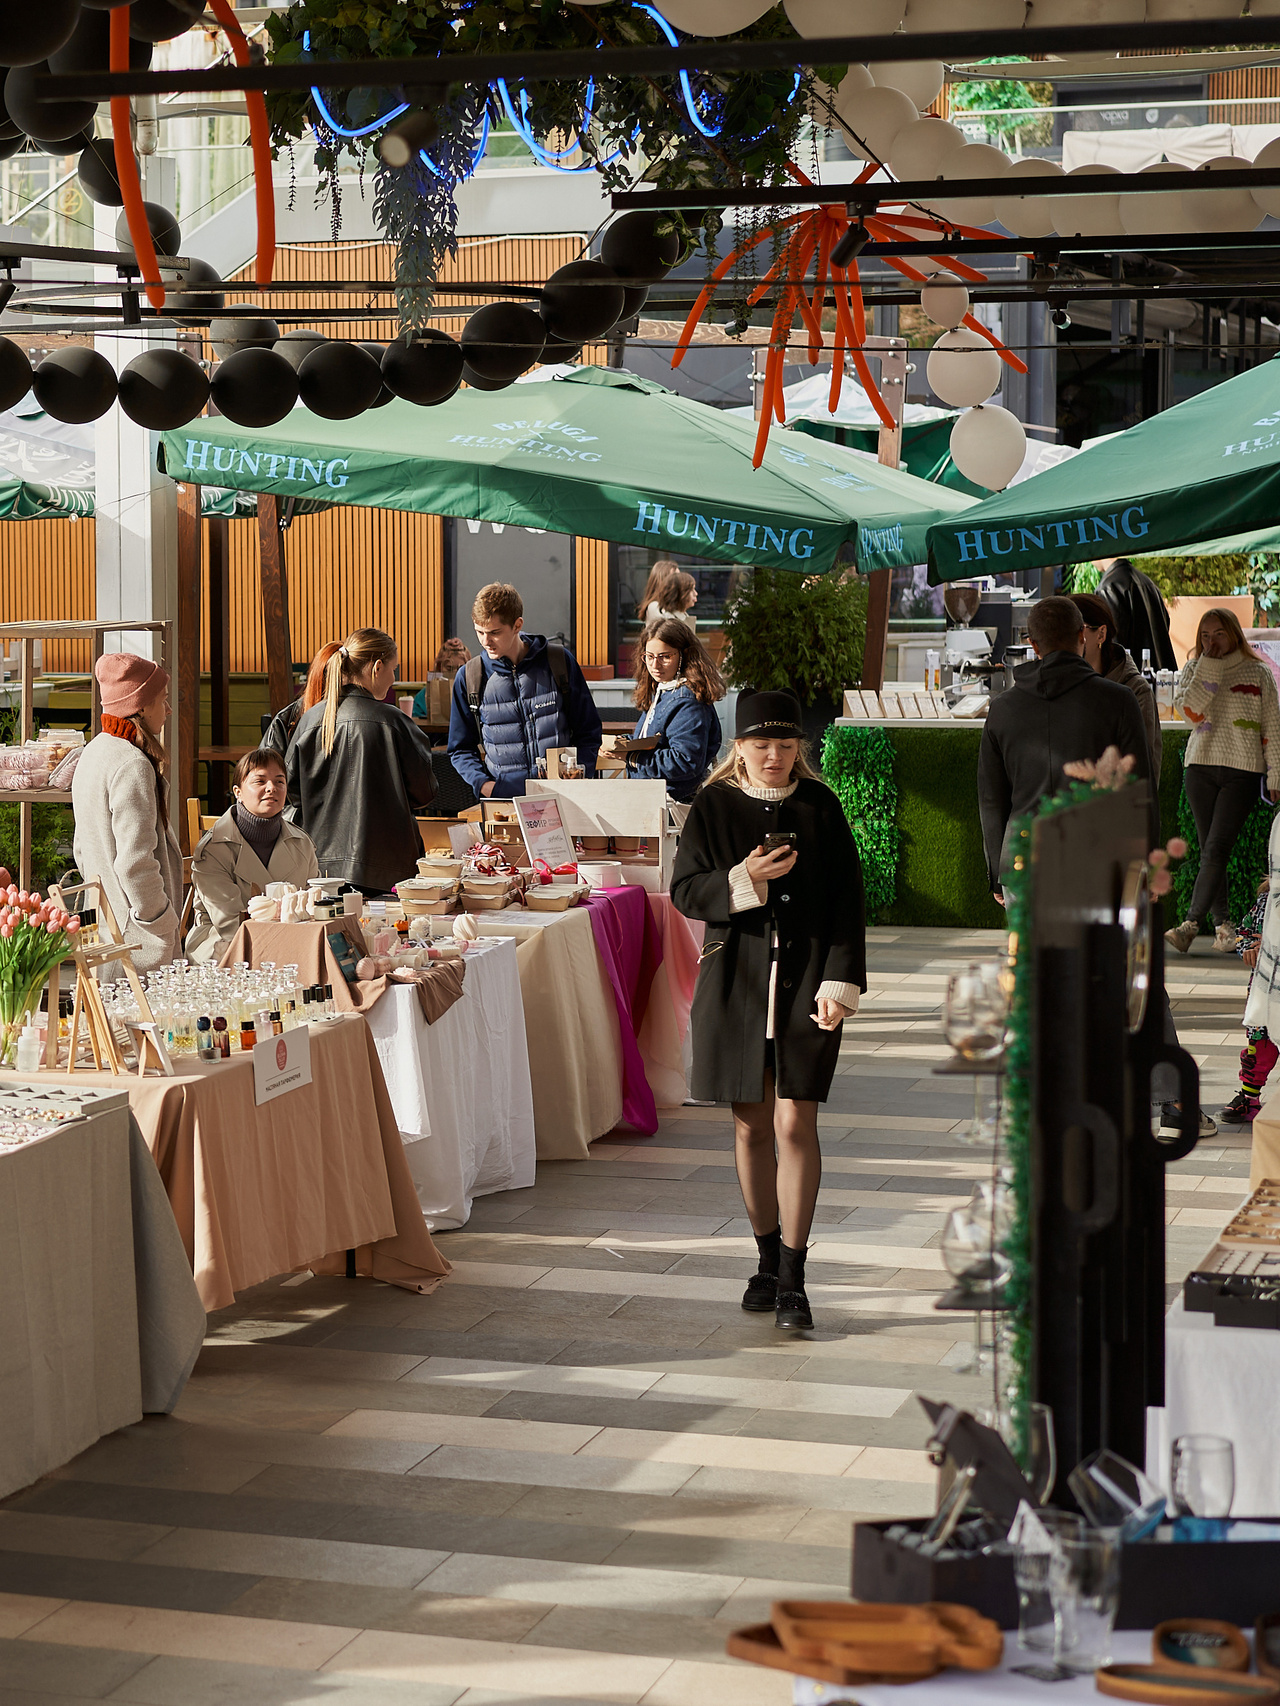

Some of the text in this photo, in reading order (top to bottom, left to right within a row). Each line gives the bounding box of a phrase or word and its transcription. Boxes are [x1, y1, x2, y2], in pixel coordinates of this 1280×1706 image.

[447, 434, 603, 462] HUNTING
[492, 420, 599, 443] BELUGA
[183, 439, 349, 488] HUNTING
[633, 500, 815, 559] HUNTING
[861, 522, 904, 559] HUNTING
[954, 505, 1150, 562] HUNTING
[525, 819, 548, 829] ЗЕФИР
